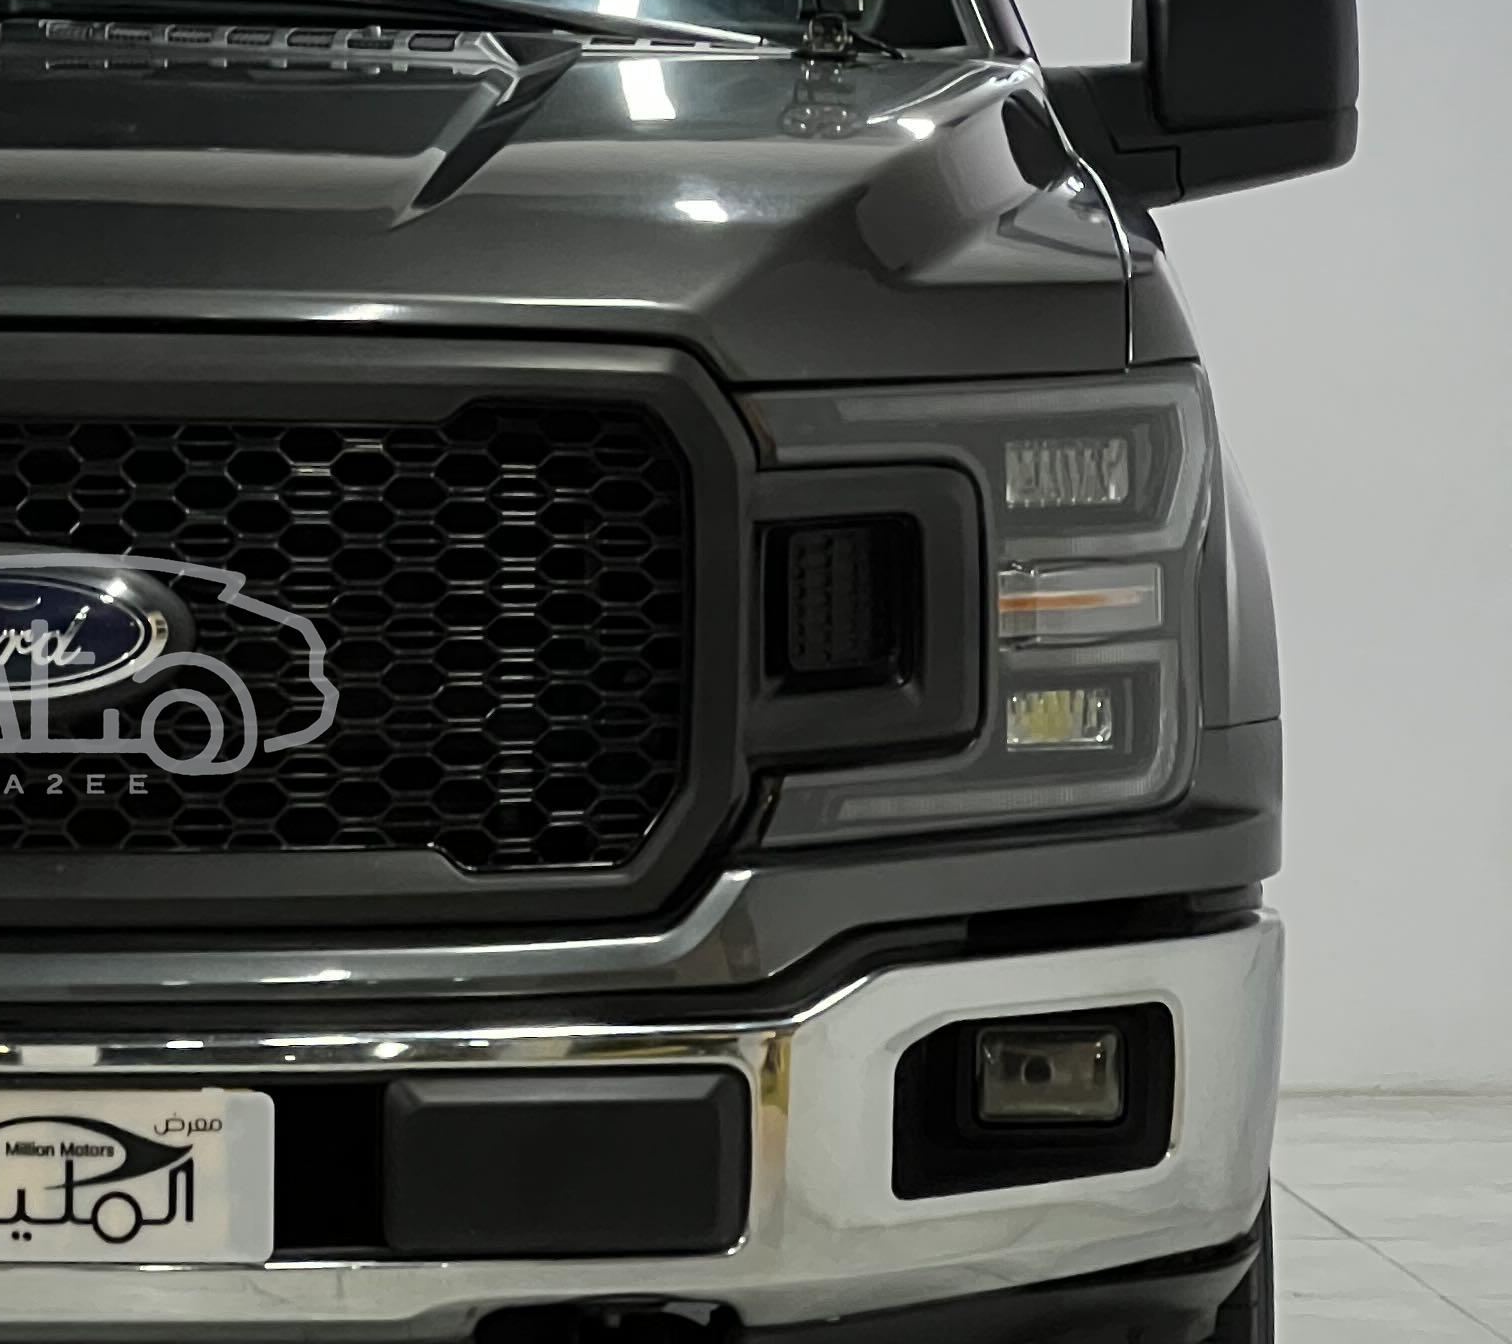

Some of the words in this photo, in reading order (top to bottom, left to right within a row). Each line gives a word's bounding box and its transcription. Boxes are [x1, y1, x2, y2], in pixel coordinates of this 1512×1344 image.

[154, 1113, 223, 1137] معرض
[5, 1142, 55, 1157] Million
[60, 1142, 115, 1157] Motors
